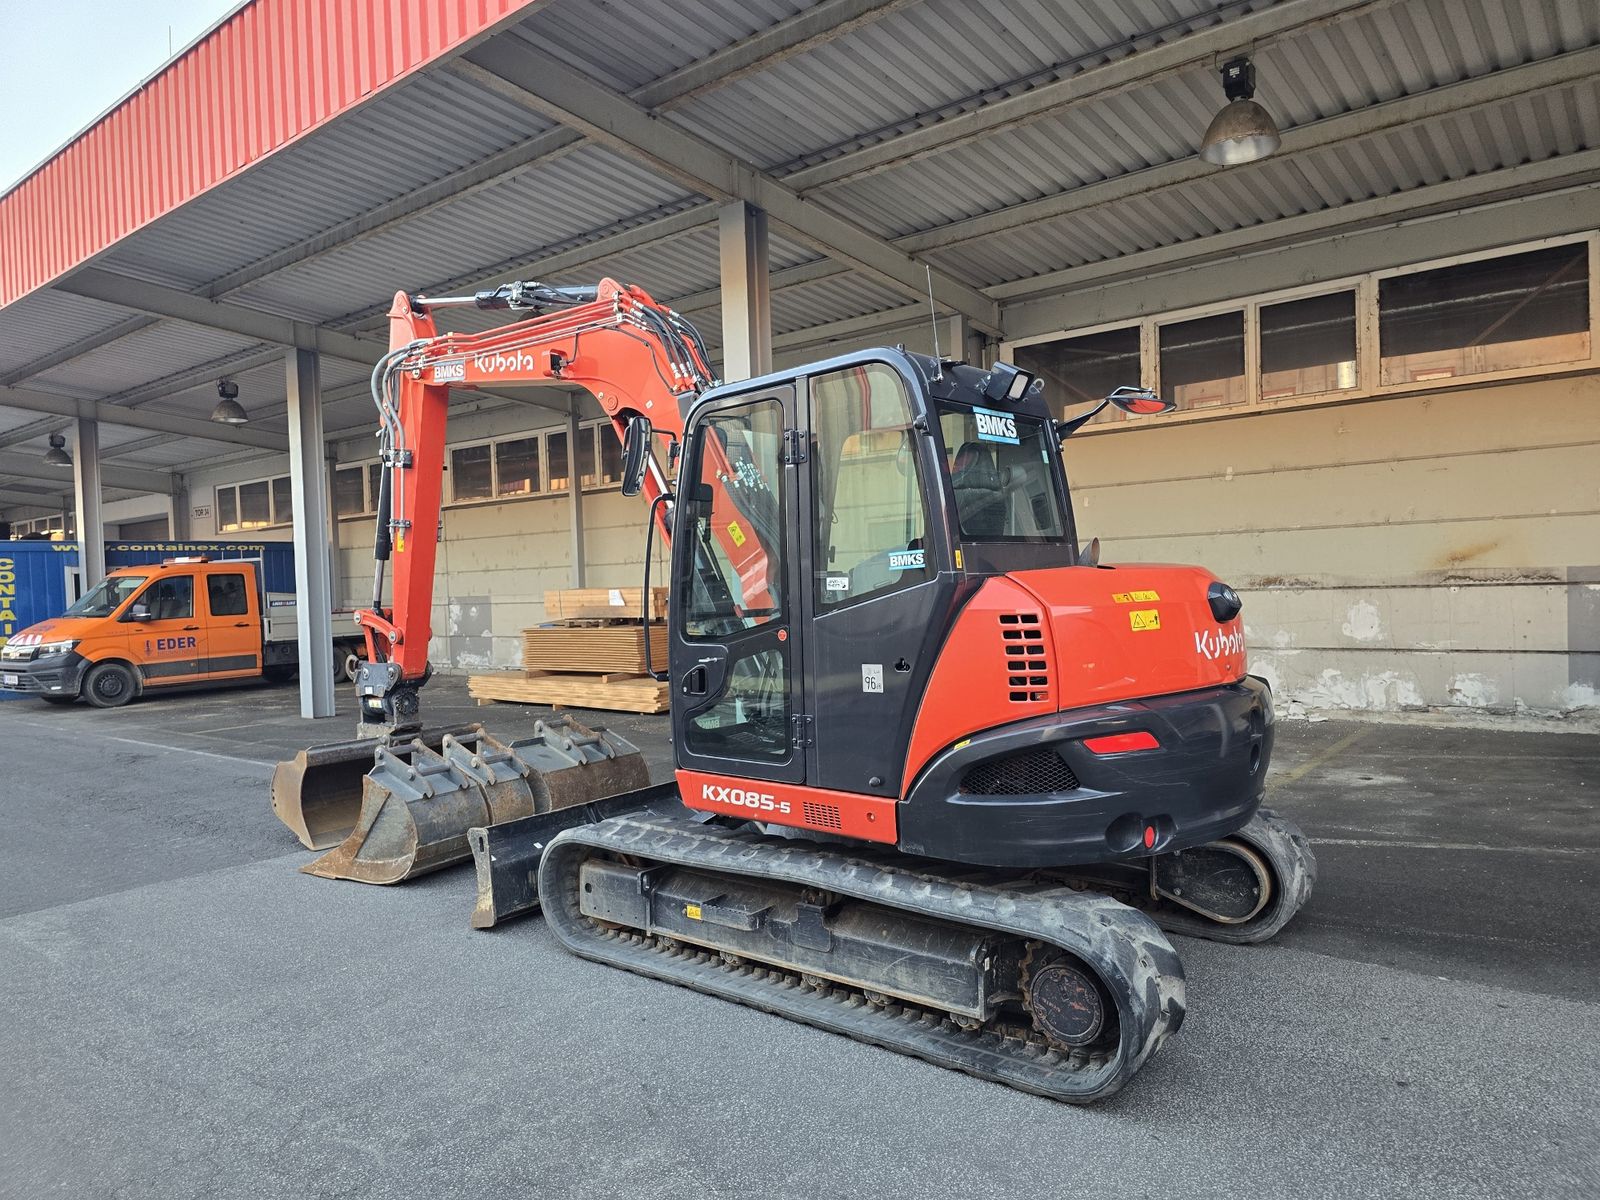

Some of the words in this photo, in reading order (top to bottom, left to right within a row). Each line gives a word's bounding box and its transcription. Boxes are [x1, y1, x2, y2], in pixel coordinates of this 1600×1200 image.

[474, 350, 534, 373] Kubota
[434, 364, 464, 379] BMKS
[975, 413, 1017, 438] BMKS
[889, 553, 924, 567] BMKS
[157, 636, 196, 650] EDER
[1194, 626, 1244, 660] Kubota
[864, 676, 877, 690] 96
[702, 784, 791, 814] KX085-5
